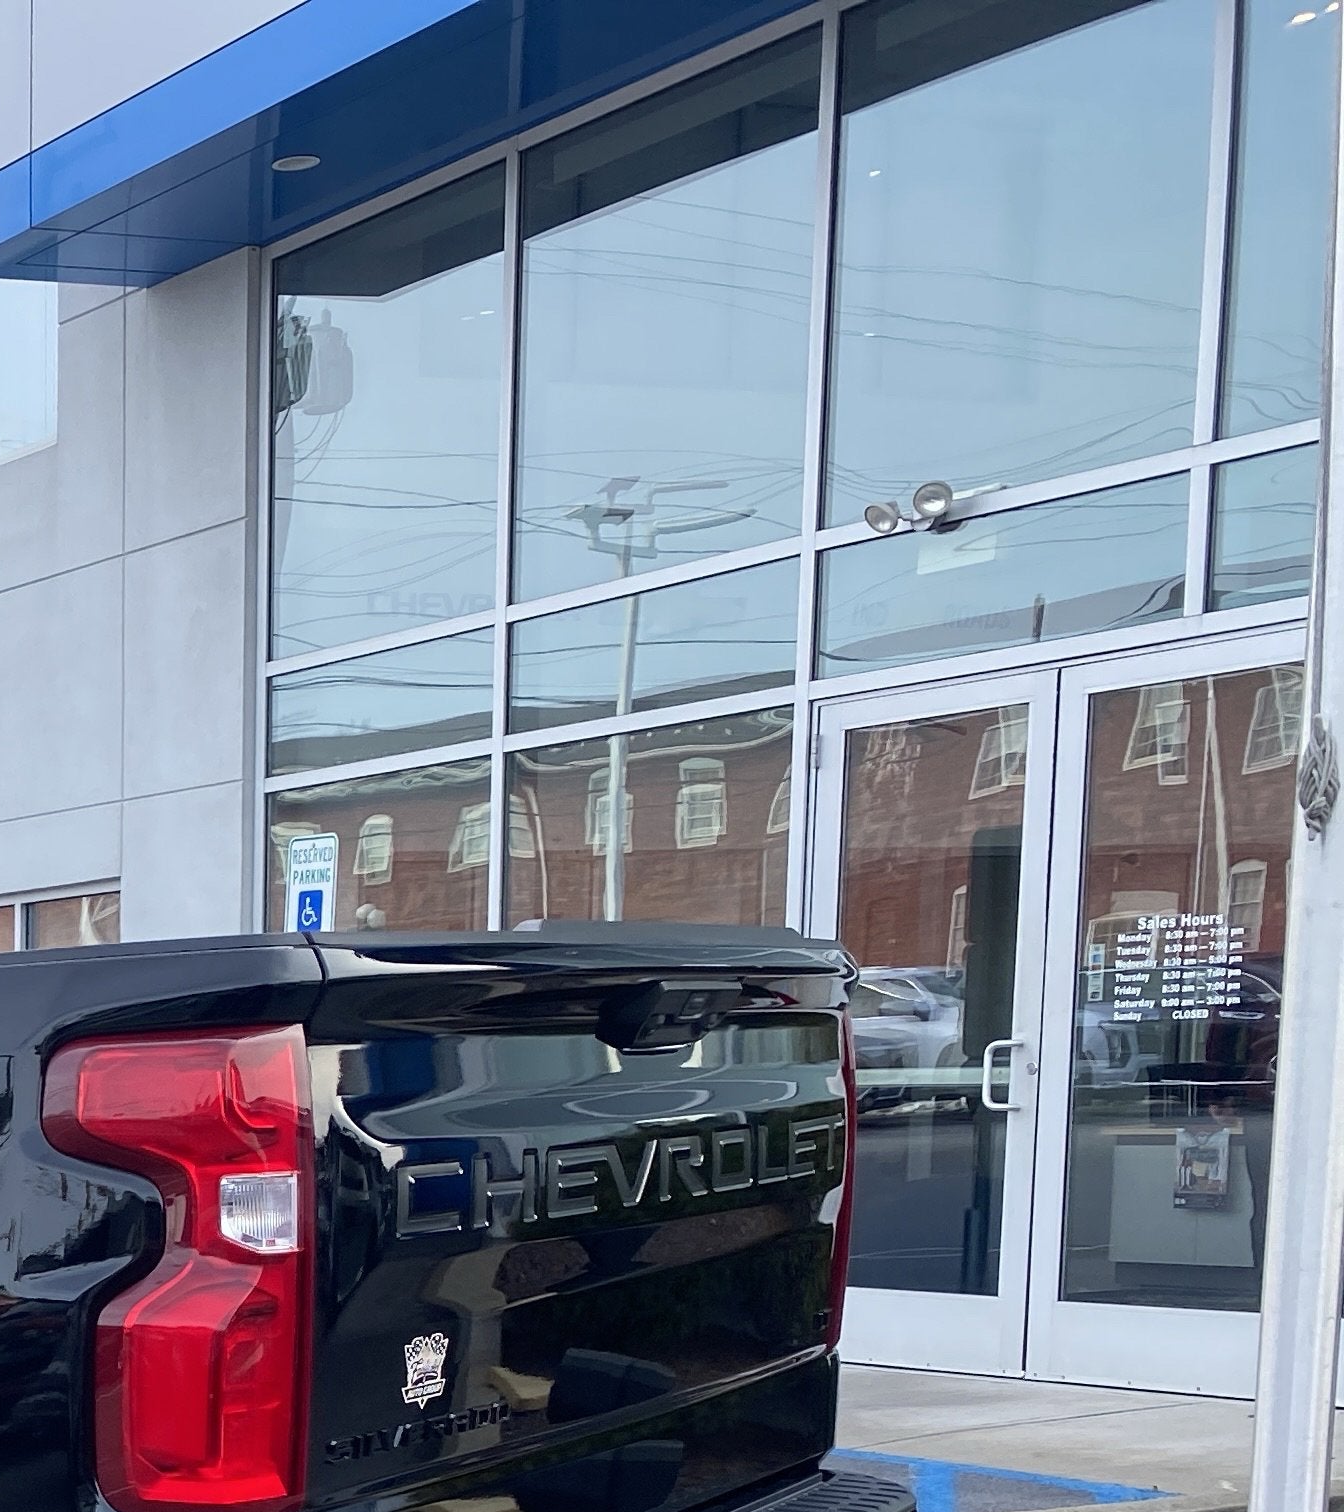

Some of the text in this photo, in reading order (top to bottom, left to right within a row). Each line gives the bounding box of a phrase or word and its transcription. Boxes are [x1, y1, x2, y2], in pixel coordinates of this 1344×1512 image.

[292, 846, 333, 865] RESERVED
[292, 867, 331, 885] PARKING
[1137, 913, 1224, 931] Sales Hours
[1117, 933, 1152, 945] Monday
[1116, 945, 1151, 957] Tuesday
[1114, 972, 1150, 984] Thursday
[1114, 985, 1142, 997] Friday
[1114, 998, 1156, 1009] Saturday
[1113, 1008, 1210, 1022] Sunday CLOSED
[395, 1112, 845, 1241] CHEVROLET
